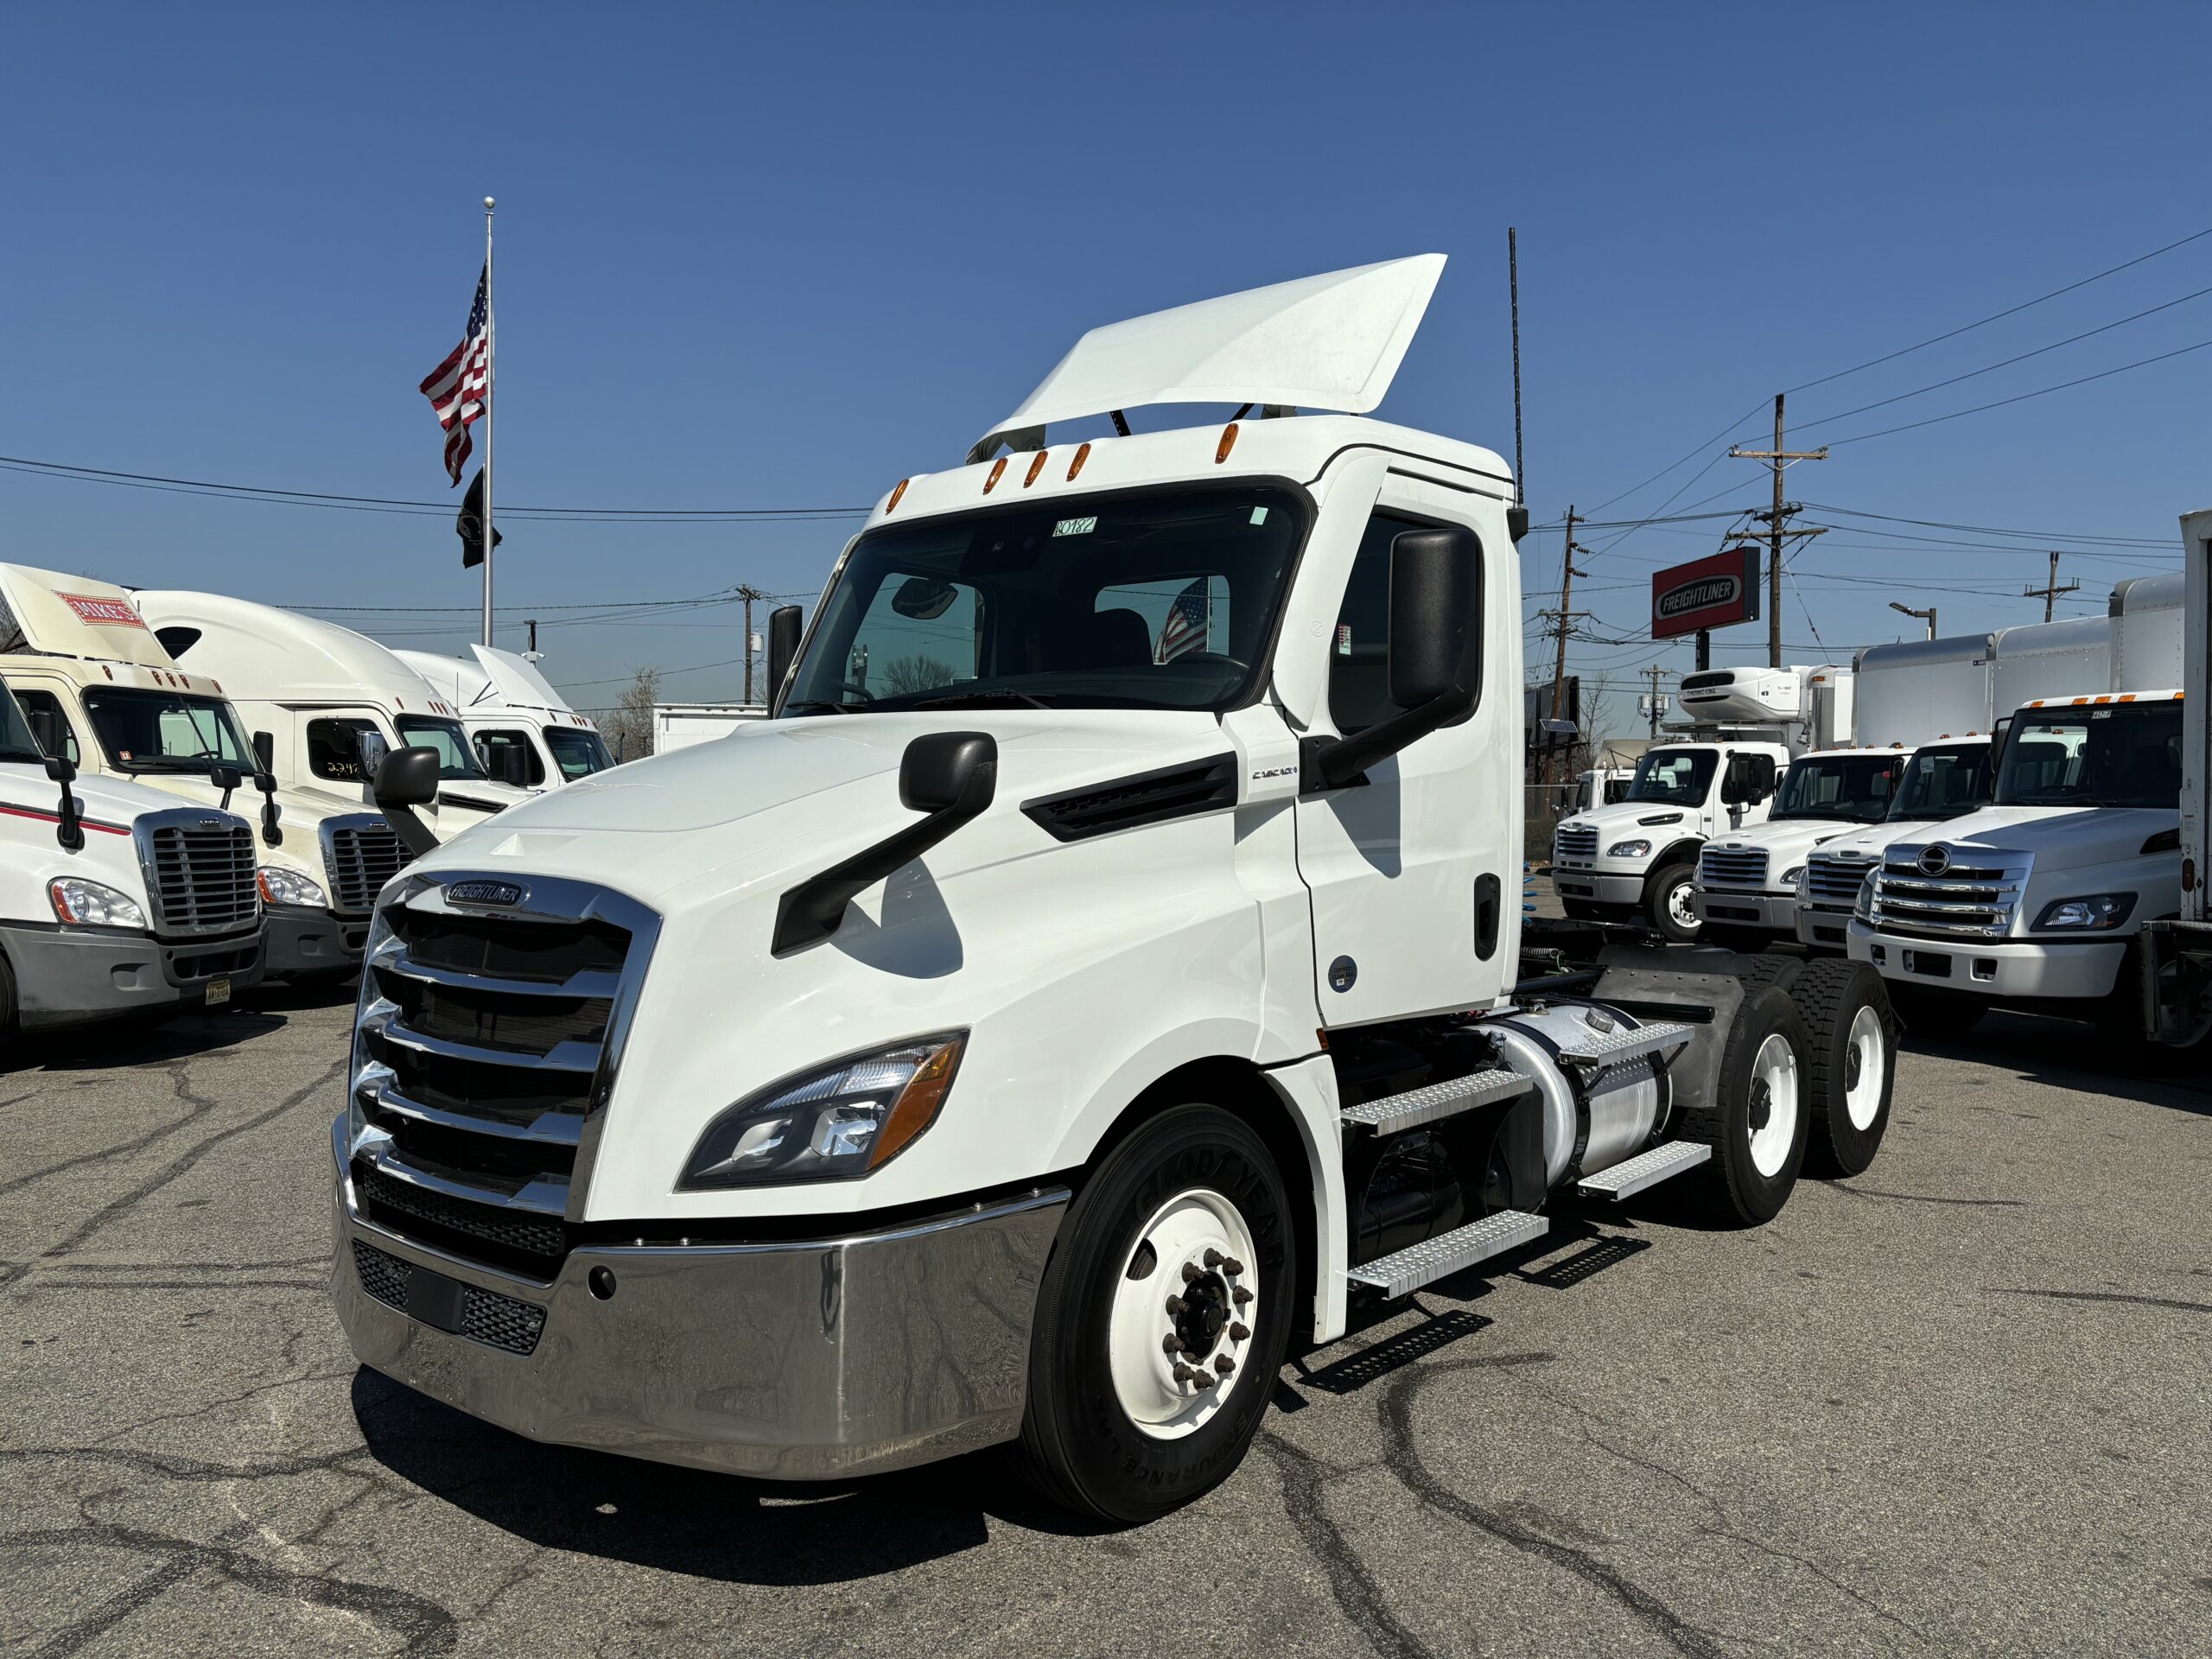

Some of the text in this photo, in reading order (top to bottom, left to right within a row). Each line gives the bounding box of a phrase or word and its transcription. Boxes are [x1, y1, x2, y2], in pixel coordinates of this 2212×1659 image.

[1662, 581, 1732, 613] FREIGHTLINER
[73, 601, 135, 620] MIKE'S
[450, 883, 519, 901] FREIGHTLINER
